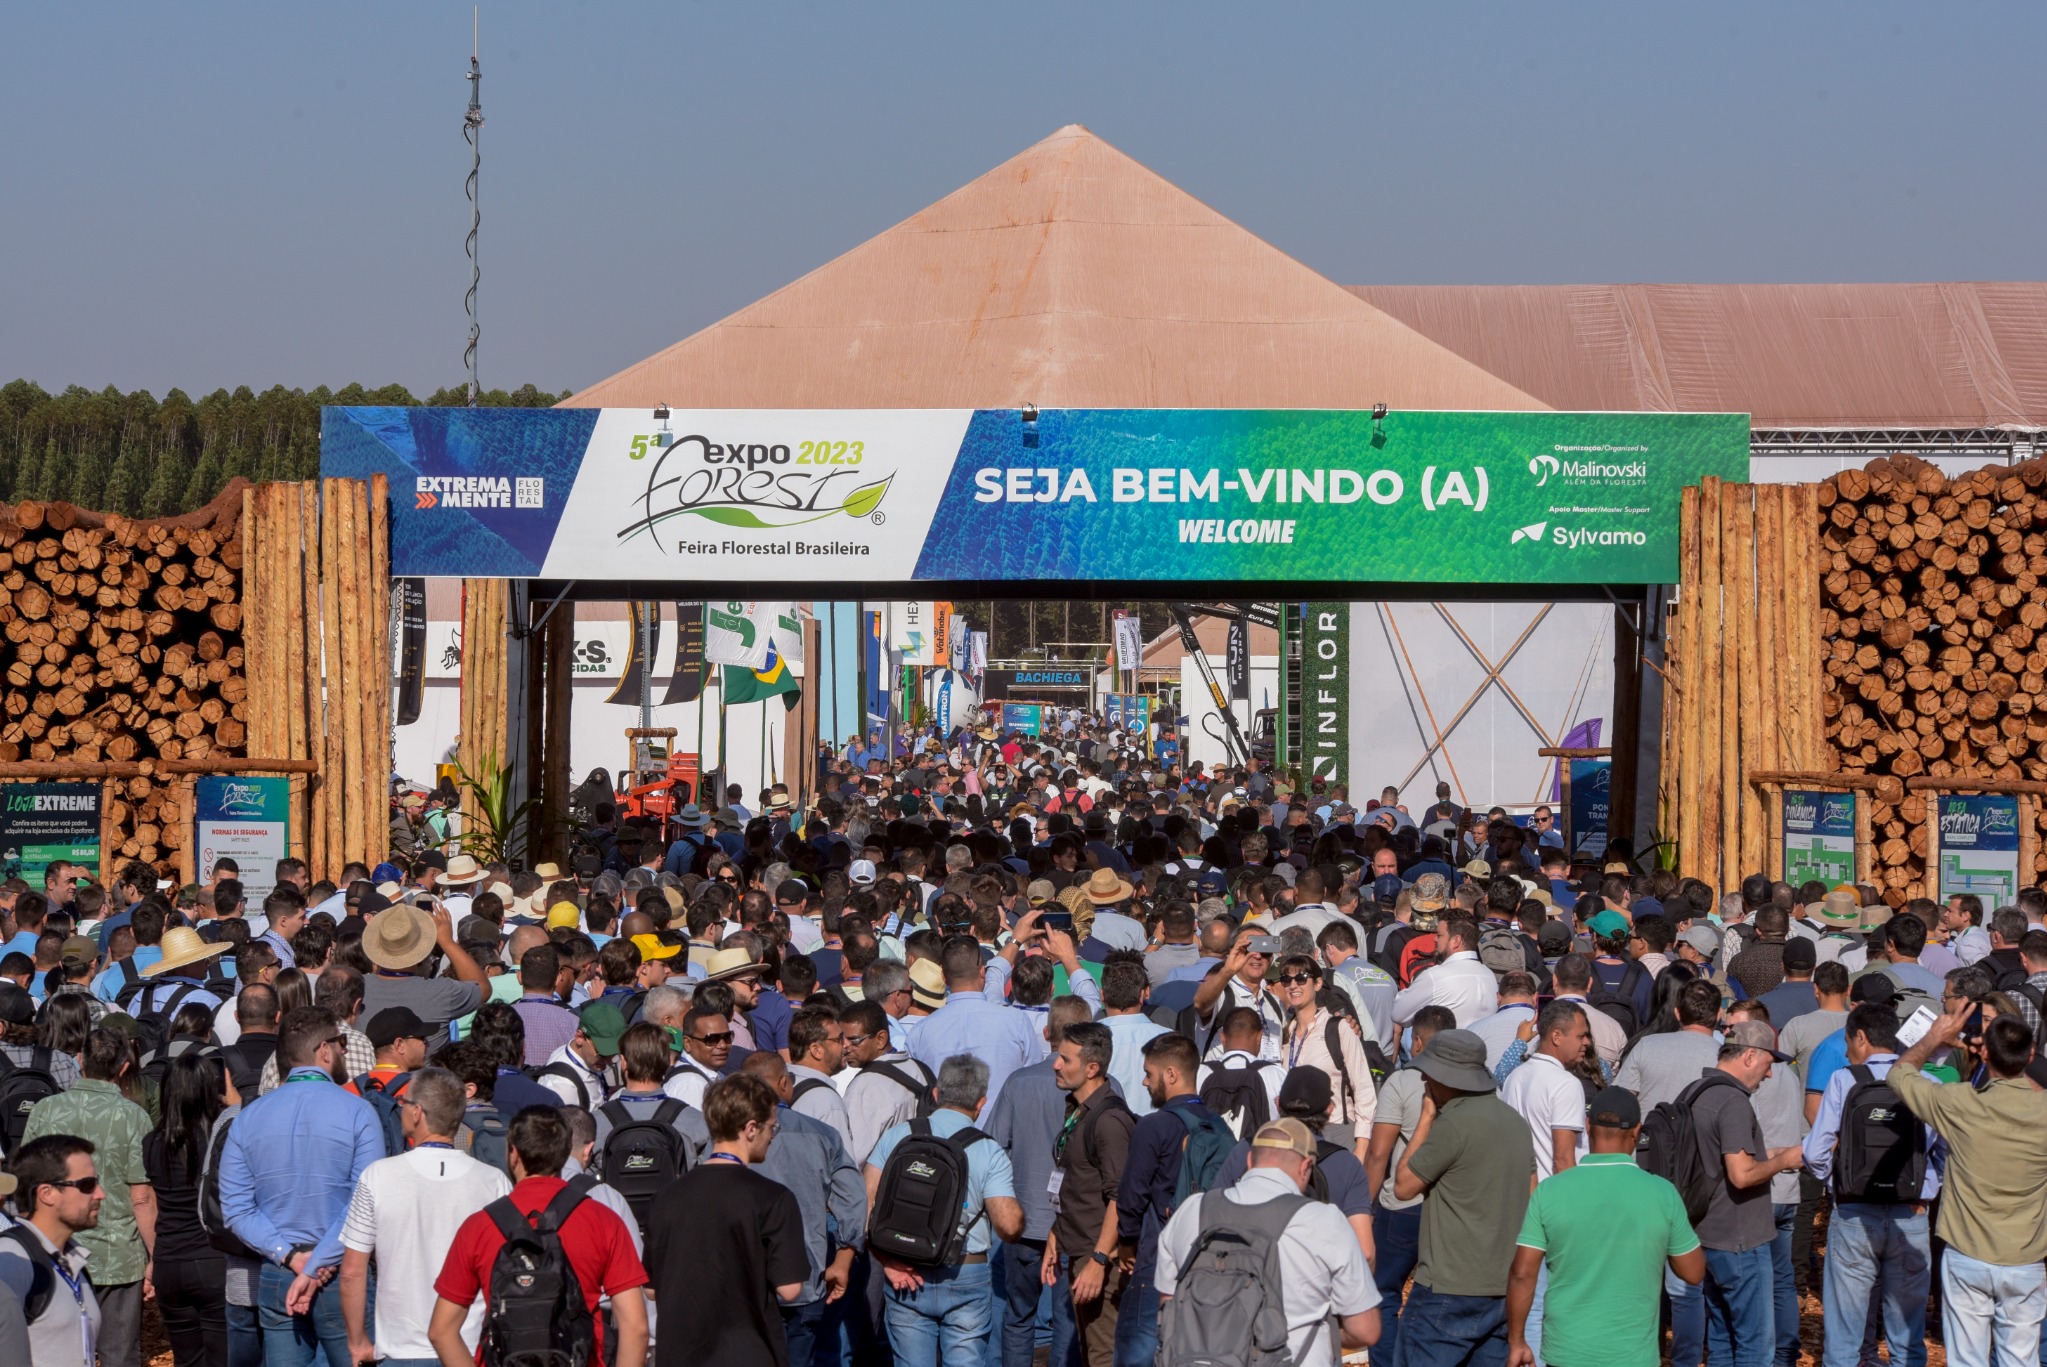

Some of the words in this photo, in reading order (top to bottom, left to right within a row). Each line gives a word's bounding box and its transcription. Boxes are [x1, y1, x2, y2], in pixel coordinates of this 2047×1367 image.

[703, 442, 791, 471] expo
[796, 440, 865, 465] 2023
[1563, 461, 1647, 477] Malinovski
[416, 476, 512, 492] EXTREMA
[518, 480, 540, 488] FLO
[1564, 477, 1586, 485] ALÉM
[518, 488, 540, 496] RES
[974, 467, 1098, 503] SEJA
[1112, 467, 1404, 505] BEM-VINDO
[1421, 465, 1489, 512] (A)
[441, 492, 512, 508] MENTE
[519, 496, 540, 505] TAL
[1549, 505, 1571, 514] Apoio
[1624, 506, 1650, 514] Support
[1178, 519, 1296, 543] WELCOME
[1553, 527, 1647, 549] Sylvamo
[678, 541, 718, 555] Feira
[721, 541, 791, 555] Florestal
[795, 541, 870, 556] Brasileira
[1015, 672, 1081, 683] BACHIEGA
[1317, 612, 1337, 748] INFLOR
[71, 820, 88, 828] poderá
[32, 827, 41, 835] loja
[240, 829, 268, 837] SEGURANÇA
